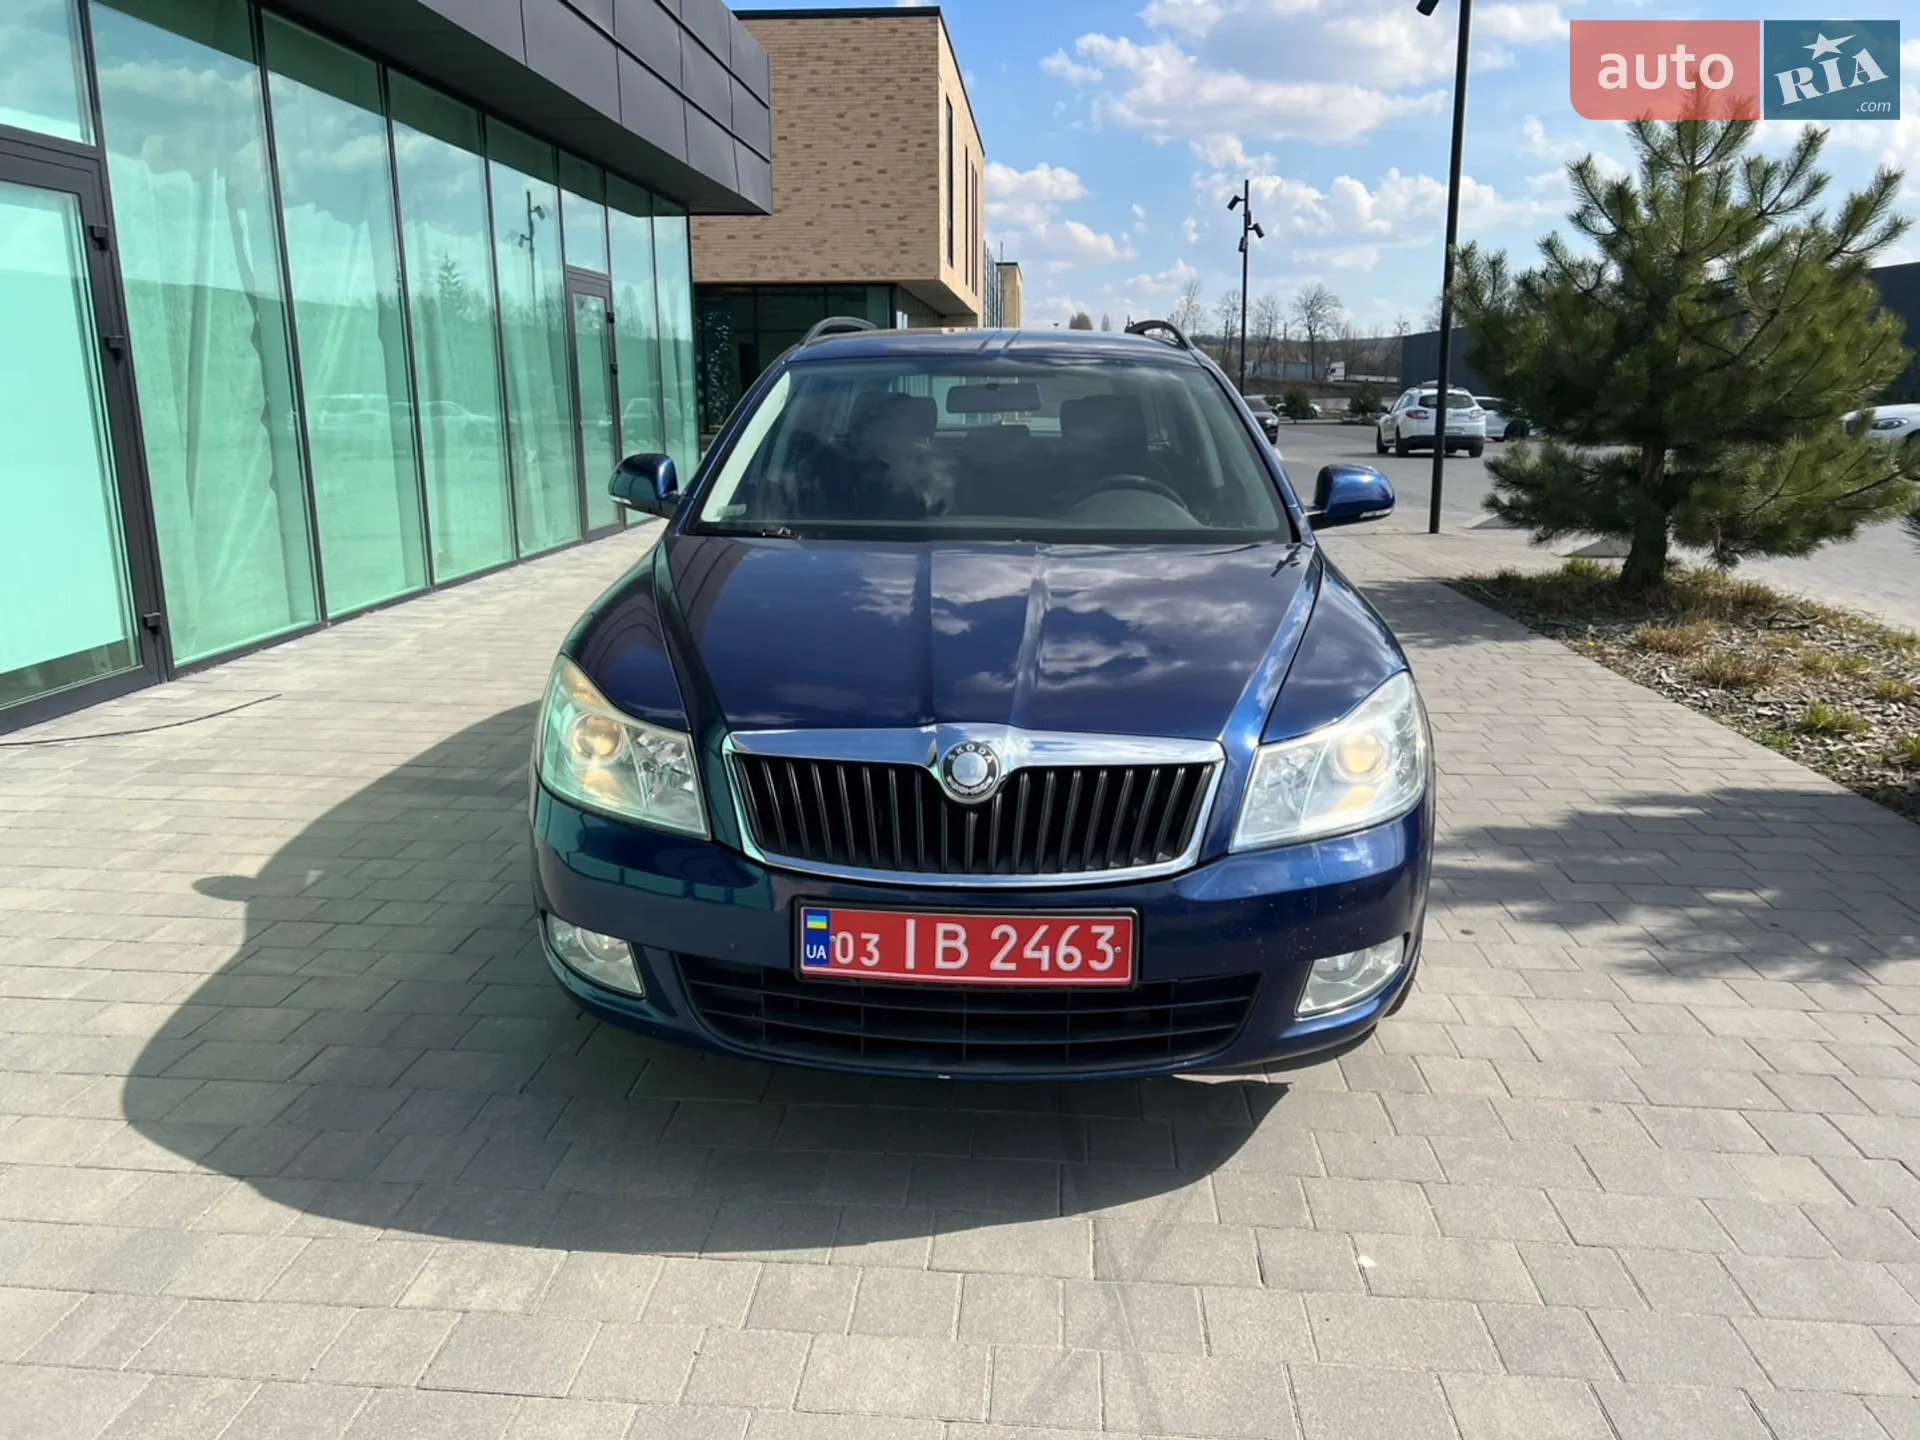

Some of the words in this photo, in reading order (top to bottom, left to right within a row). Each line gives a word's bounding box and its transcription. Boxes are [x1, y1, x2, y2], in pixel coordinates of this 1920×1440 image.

[806, 944, 827, 960] UA
[834, 931, 880, 967] 03
[990, 924, 1115, 972] 2463
